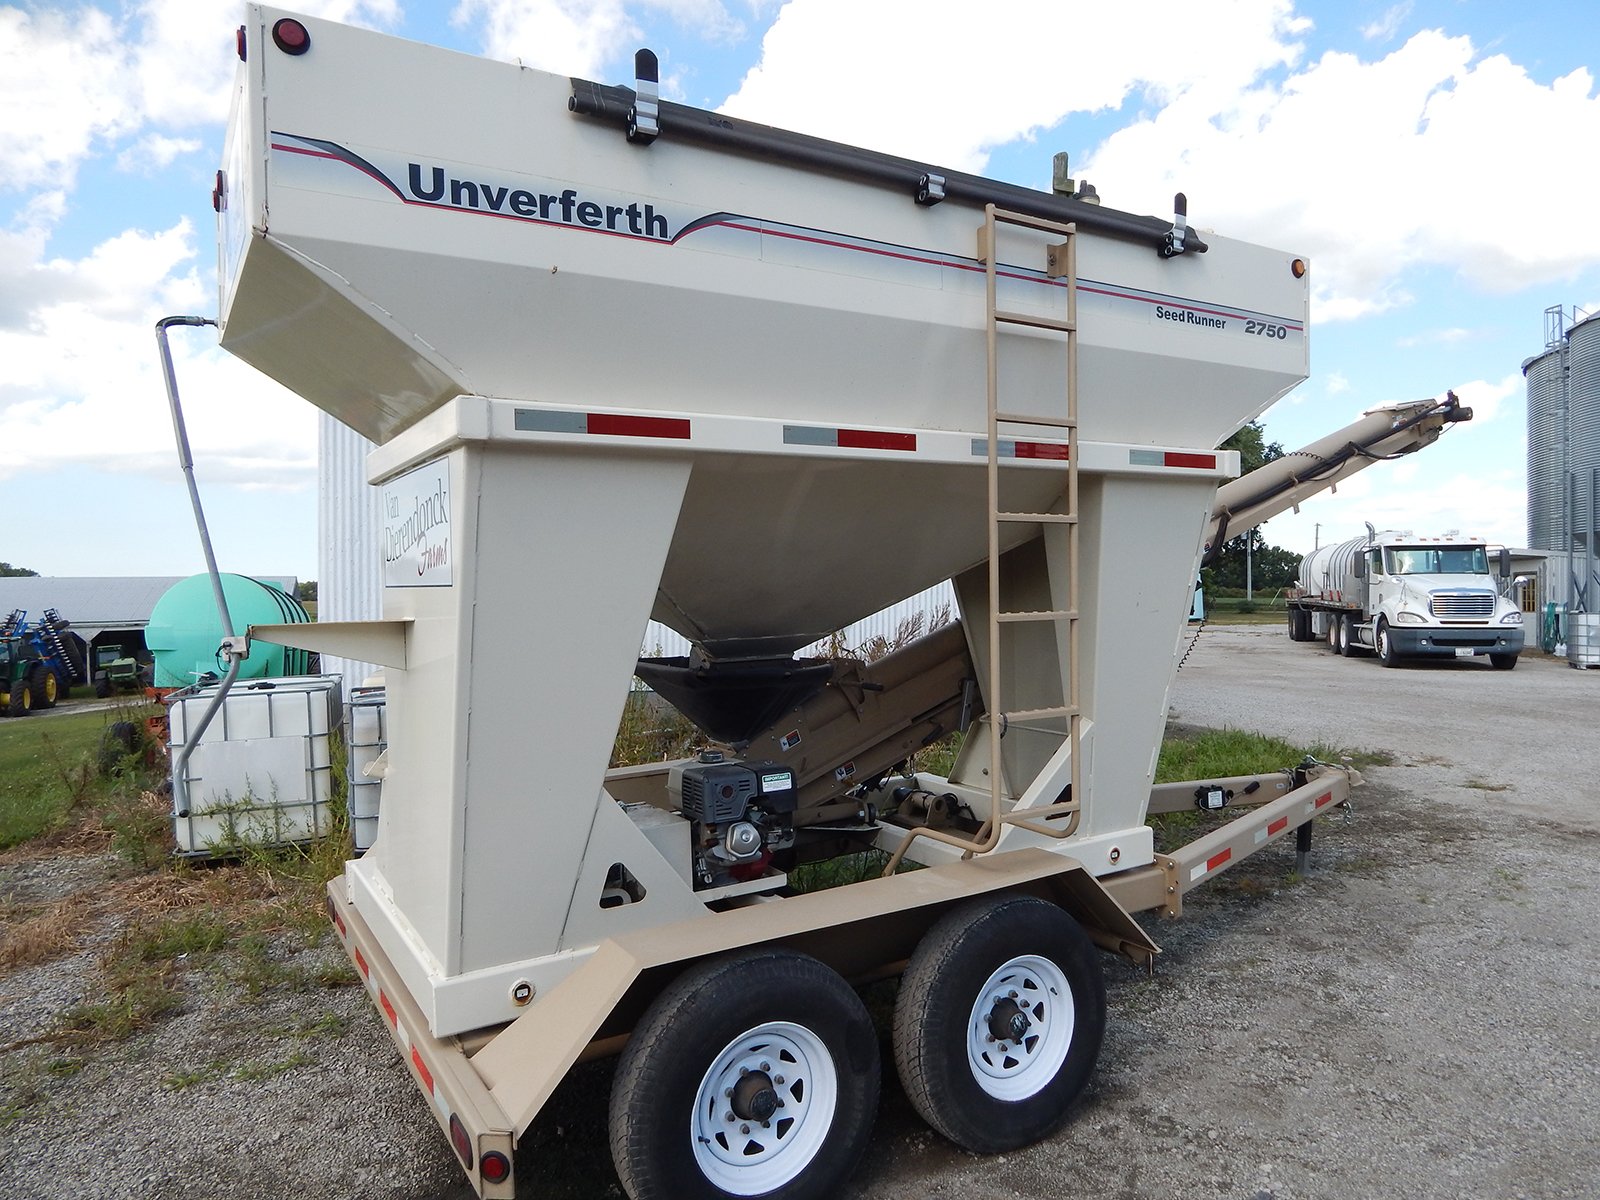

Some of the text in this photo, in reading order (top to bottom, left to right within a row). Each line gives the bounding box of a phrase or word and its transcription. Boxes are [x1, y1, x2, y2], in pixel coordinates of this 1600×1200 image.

[408, 162, 668, 239] Unverferth
[1245, 320, 1287, 340] 2750
[385, 491, 399, 519] Van
